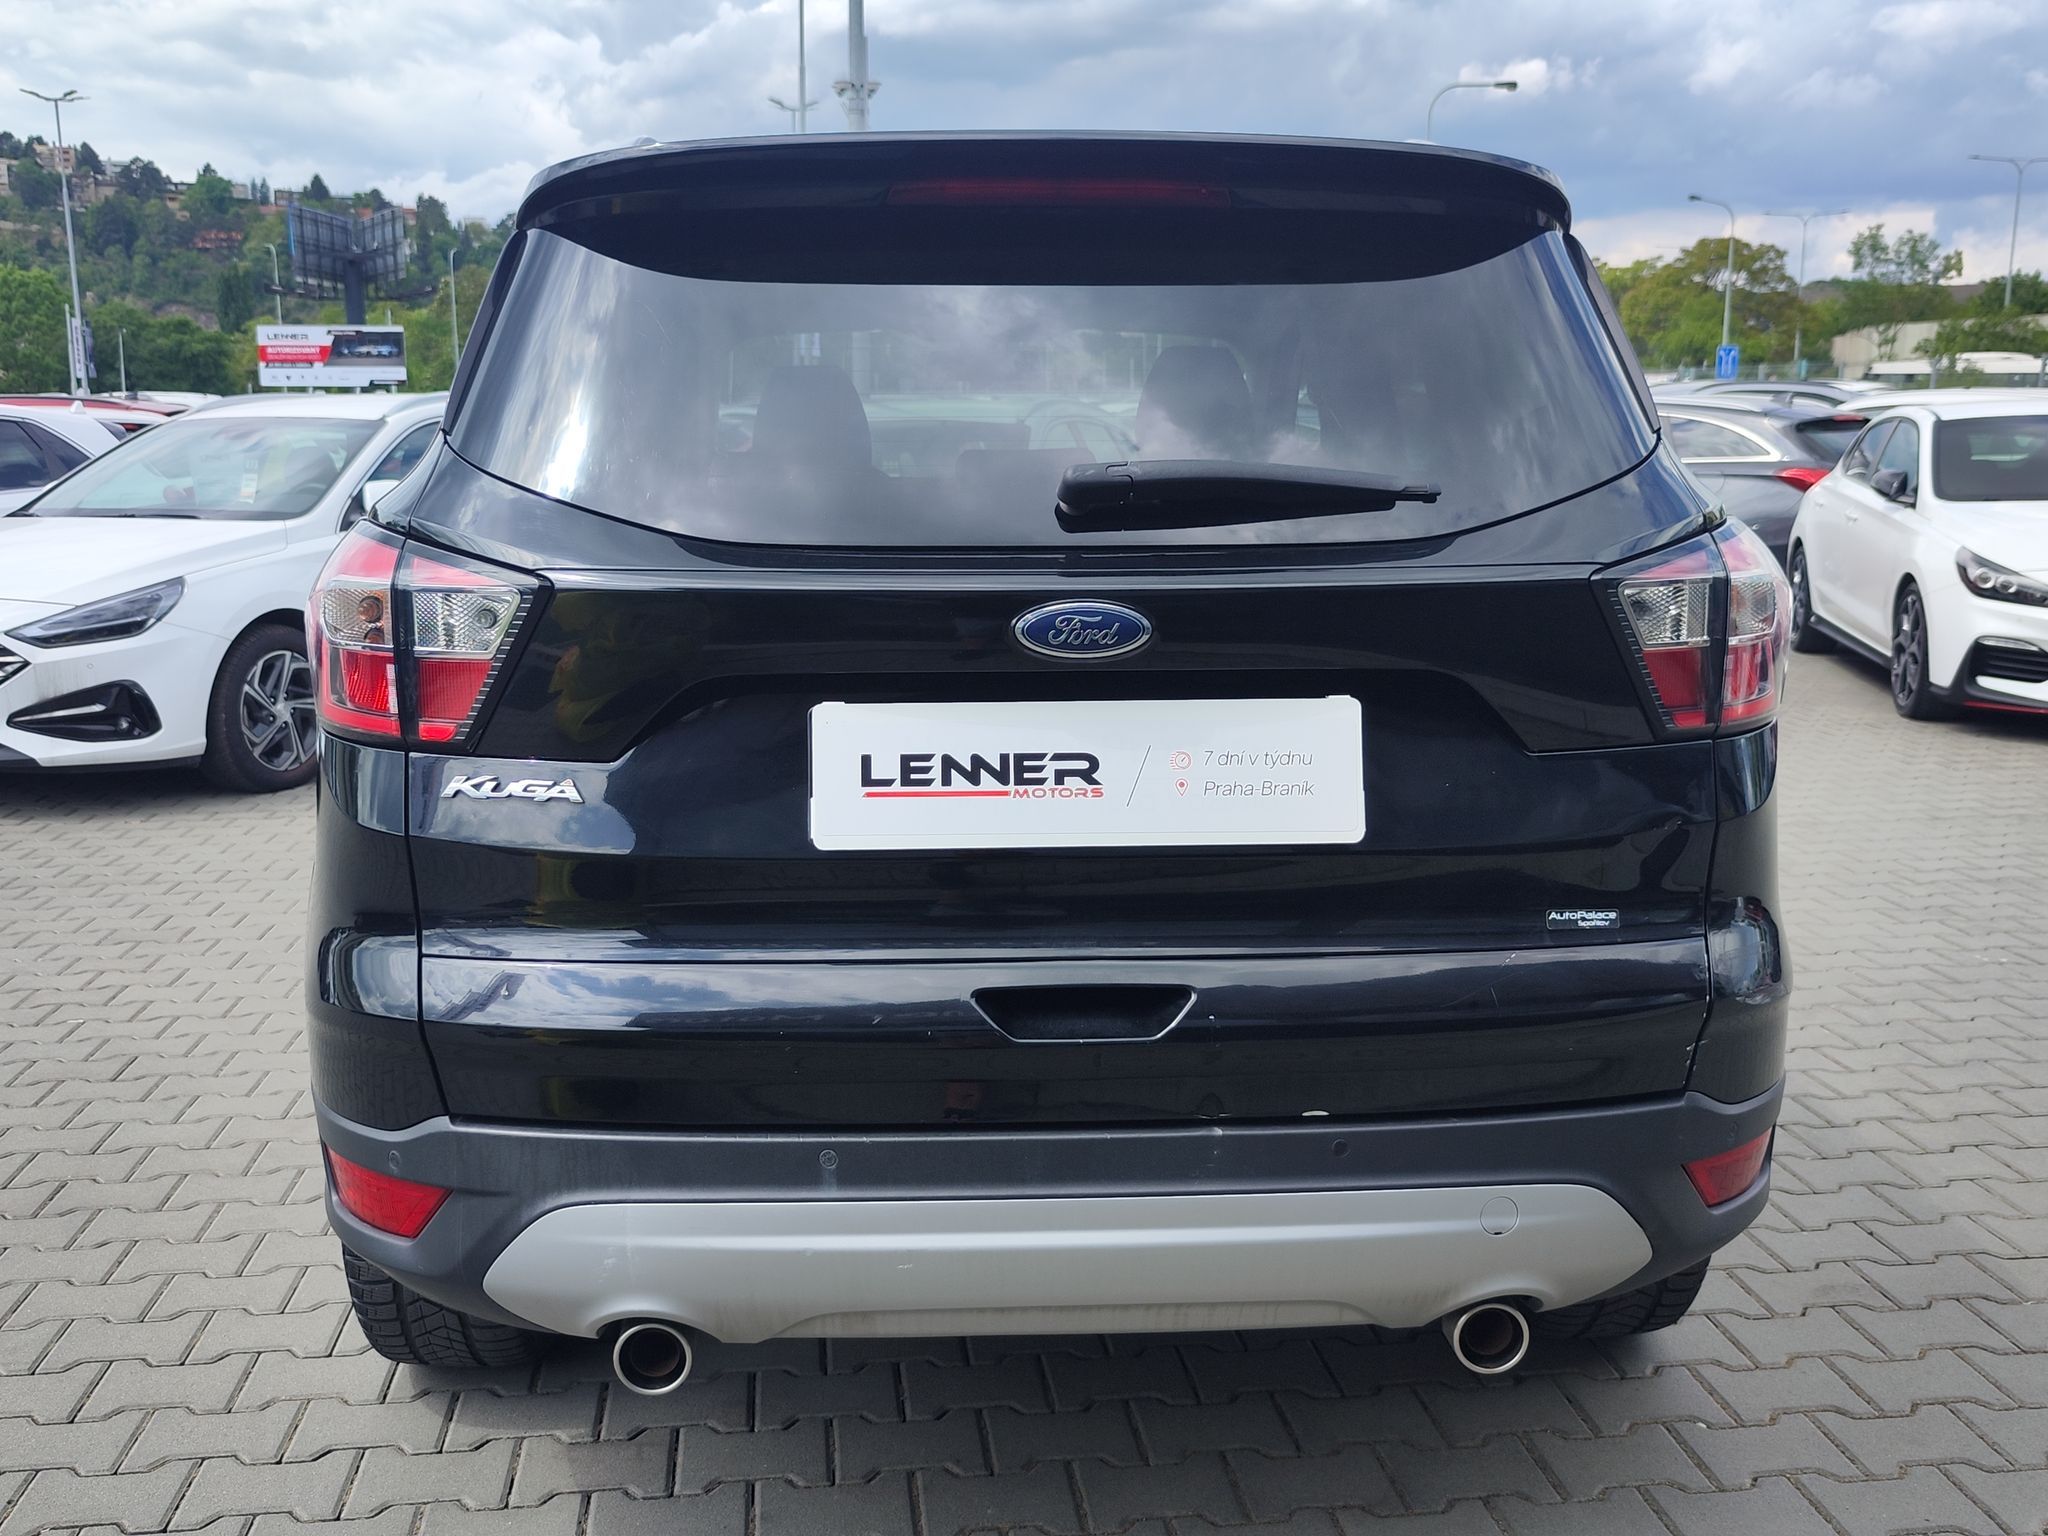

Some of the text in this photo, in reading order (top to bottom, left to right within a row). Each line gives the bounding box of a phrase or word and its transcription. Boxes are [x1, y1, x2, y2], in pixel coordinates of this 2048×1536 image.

[1047, 614, 1121, 645] Ford
[861, 752, 1103, 787] LENNER
[1203, 750, 1313, 769] 7 dní v týdnu
[440, 774, 584, 803] KUGA
[1012, 787, 1104, 798] MOTORS
[1203, 780, 1315, 797] Praha-Braník
